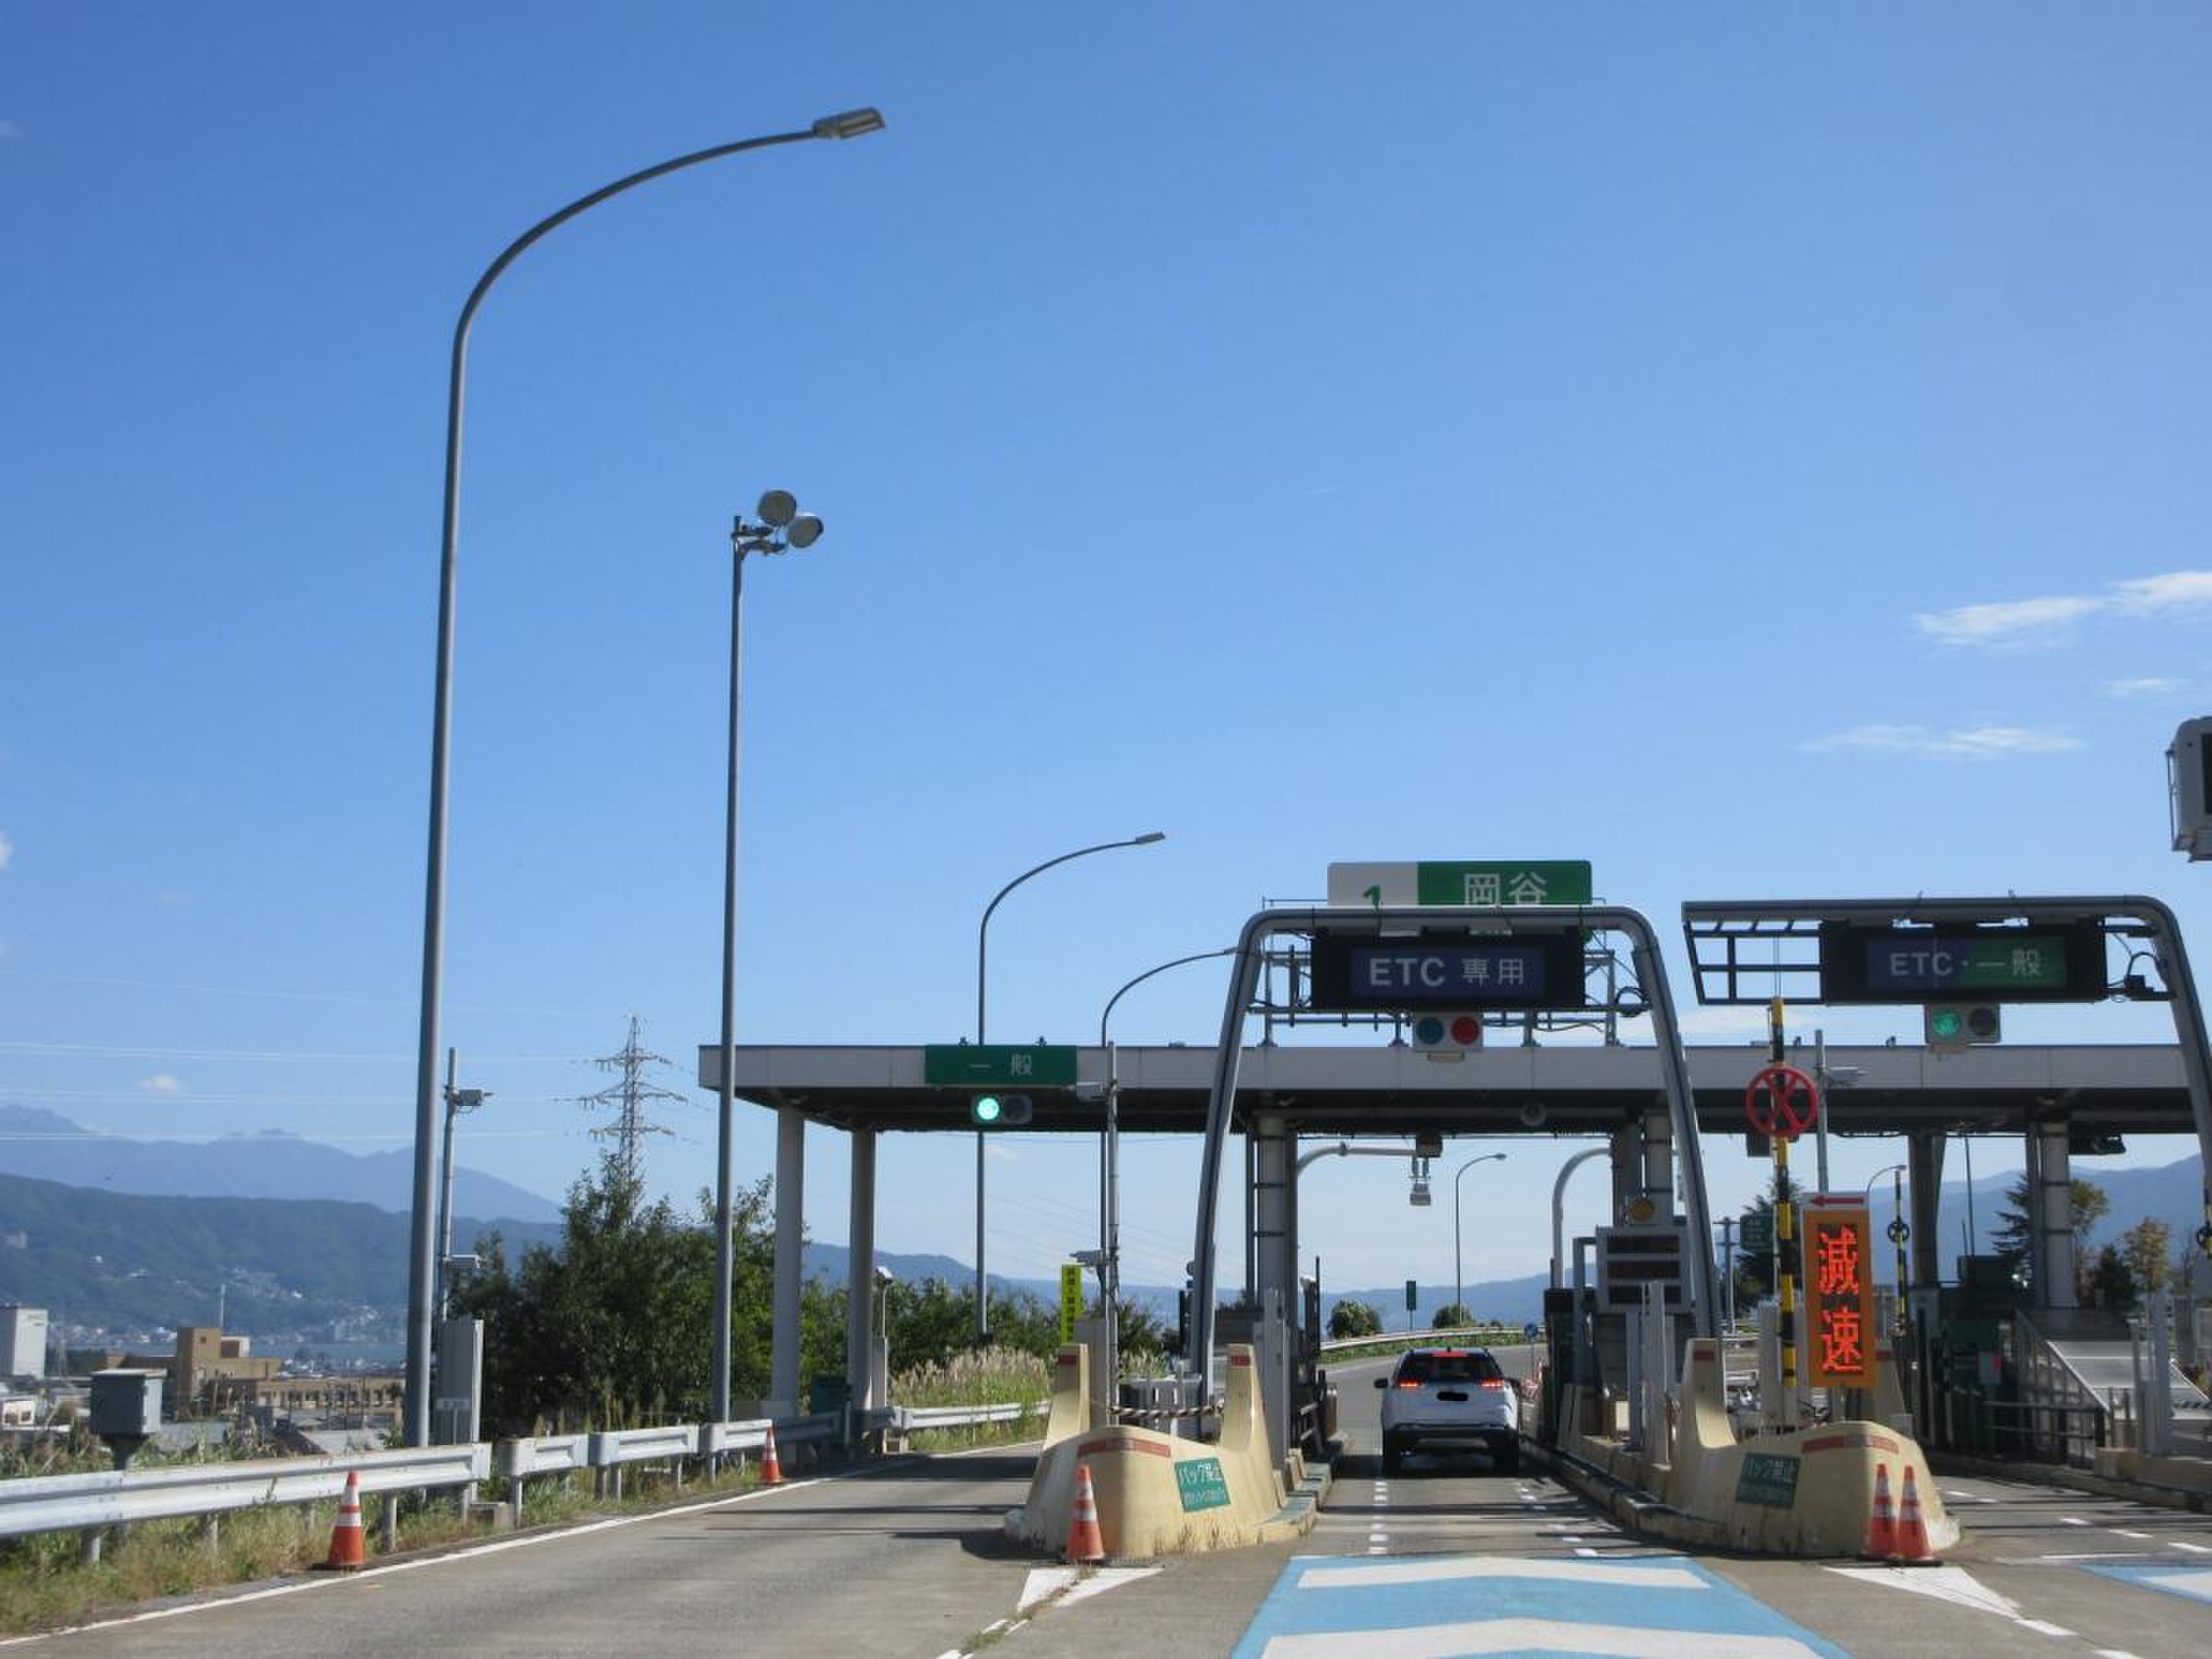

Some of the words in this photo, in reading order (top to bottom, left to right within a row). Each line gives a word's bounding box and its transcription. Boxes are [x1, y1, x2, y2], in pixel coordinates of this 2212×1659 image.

[1464, 871, 1548, 906] 岡谷
[1369, 958, 1446, 987] ETC
[1461, 957, 1524, 987] 専用
[970, 1053, 1033, 1077] 一般
[1818, 1225, 1864, 1373] 減速
